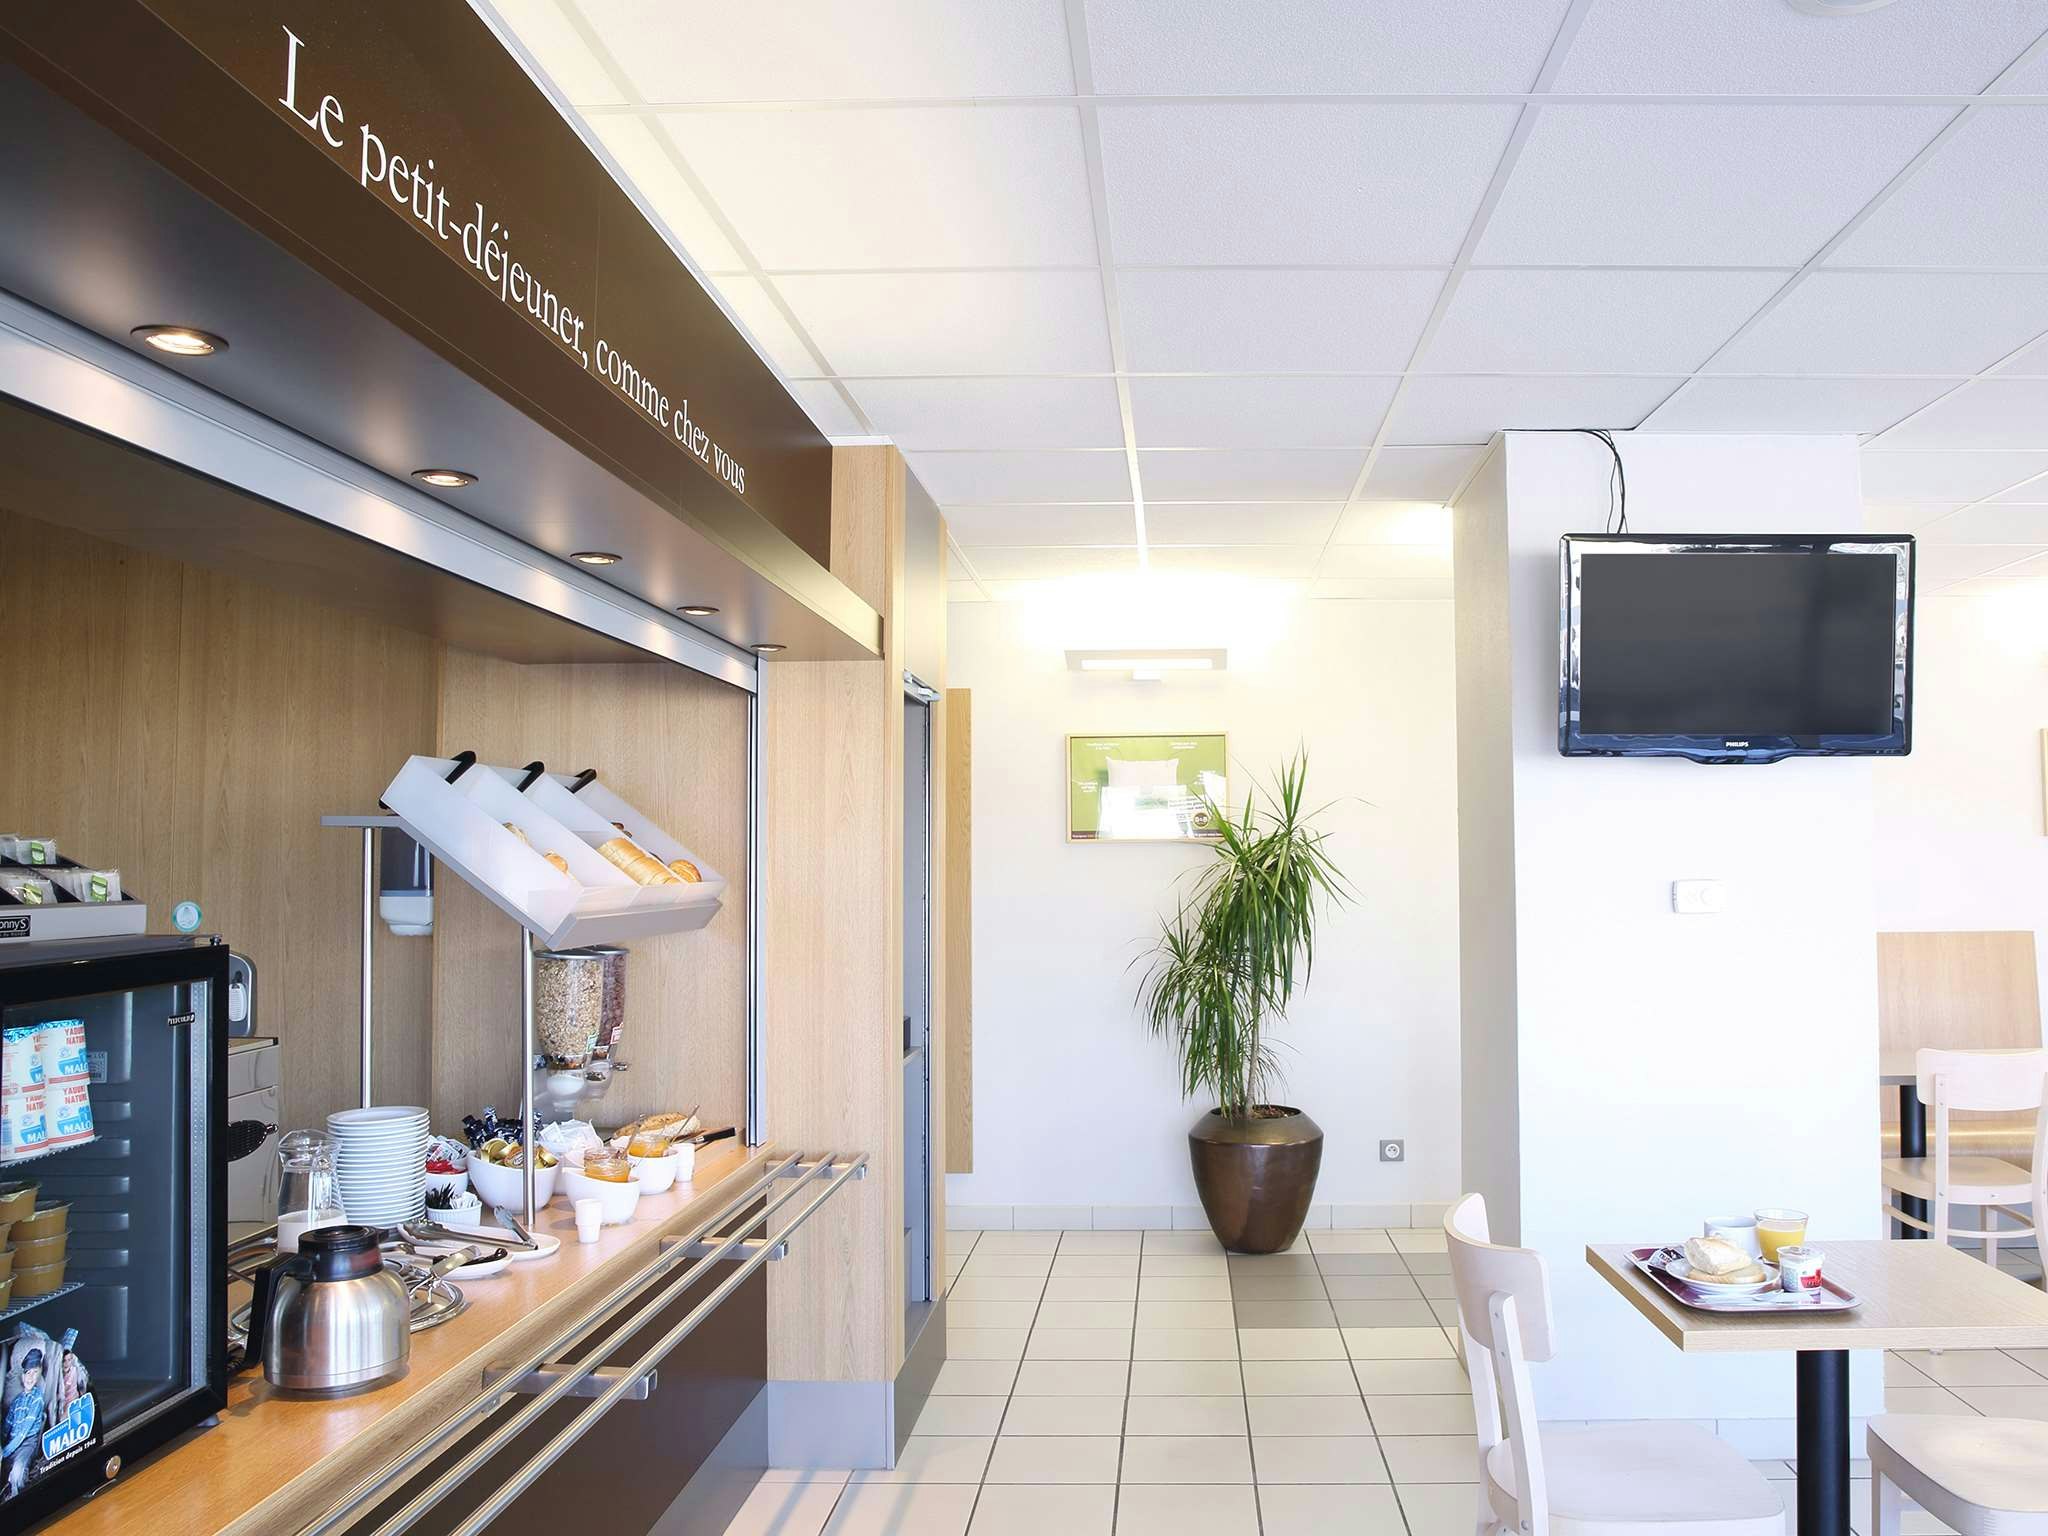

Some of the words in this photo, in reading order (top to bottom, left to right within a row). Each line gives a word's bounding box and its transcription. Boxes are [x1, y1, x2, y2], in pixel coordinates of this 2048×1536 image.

[278, 25, 344, 148] Le
[360, 124, 589, 369] petit-déjeuner,
[596, 339, 669, 428] comme
[674, 400, 710, 464] chez
[714, 443, 745, 494] vous
[64, 1121, 92, 1135] MALO
[49, 1422, 89, 1457] MALO
[39, 1456, 65, 1474] Tradition
